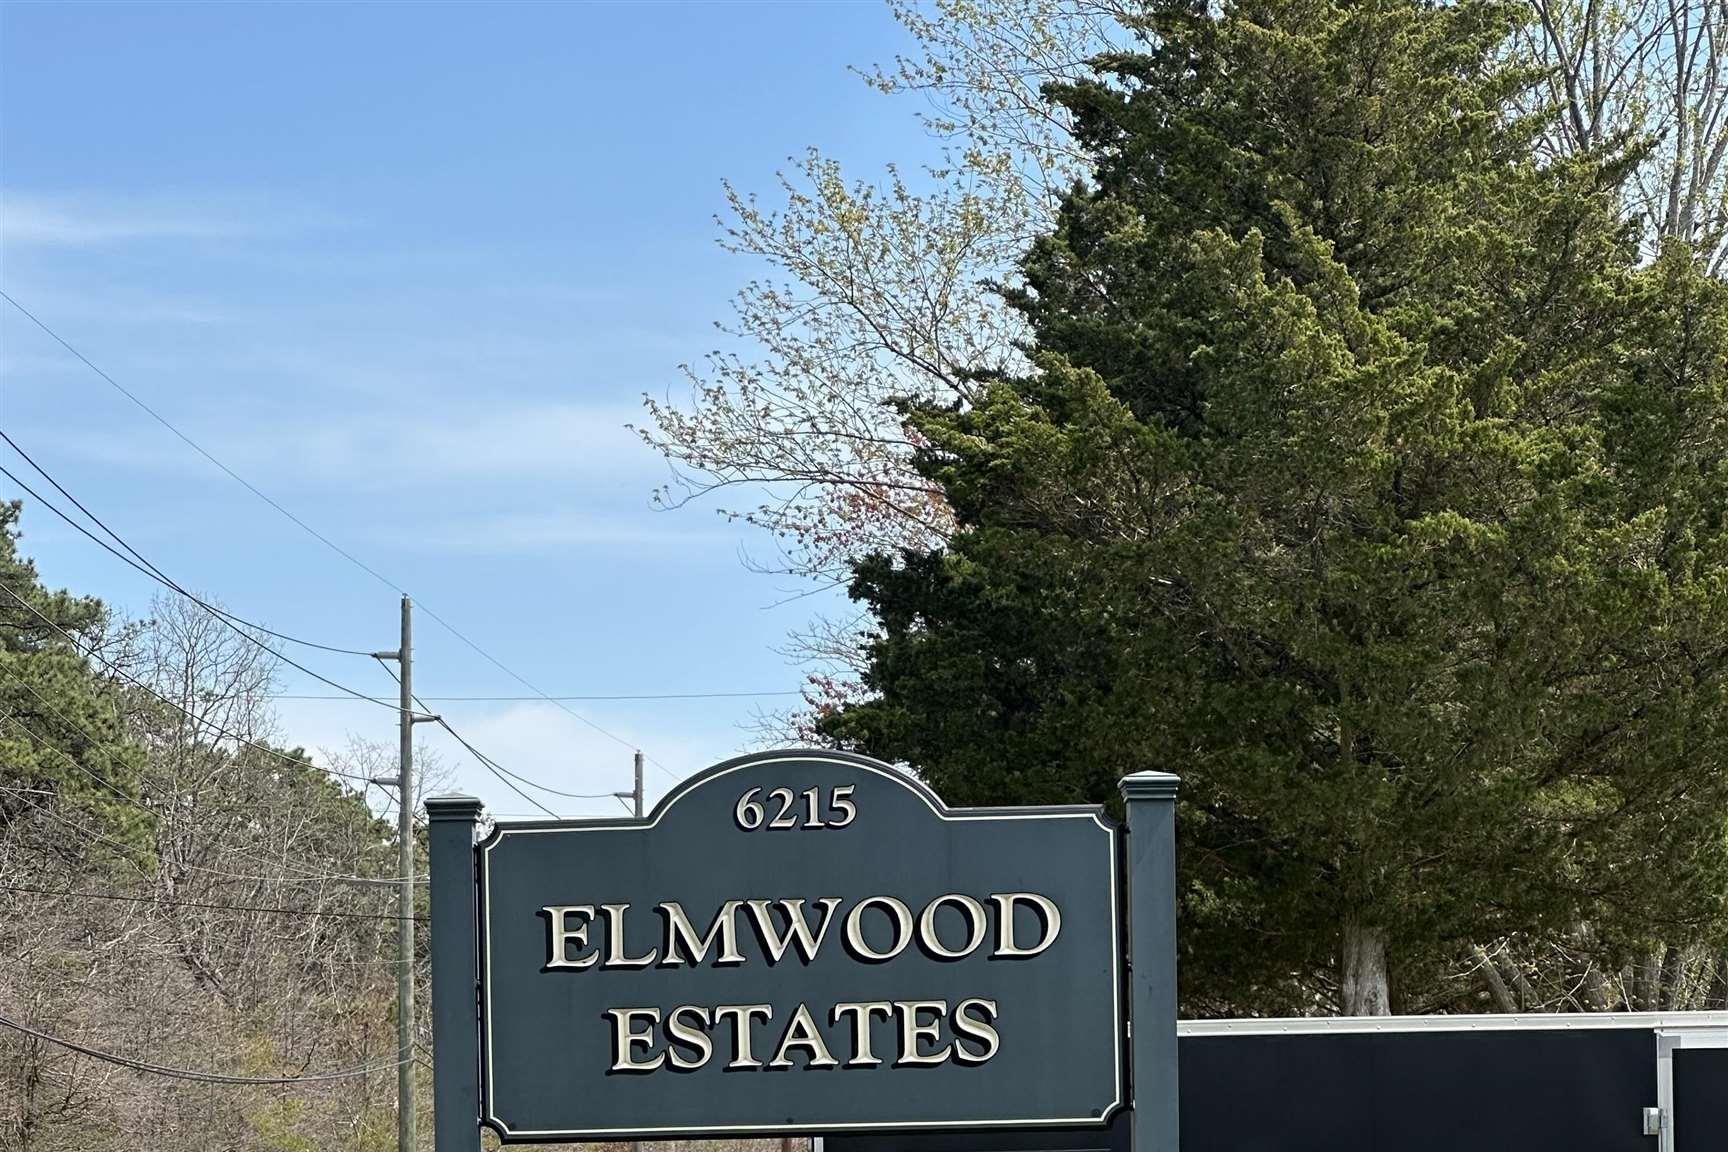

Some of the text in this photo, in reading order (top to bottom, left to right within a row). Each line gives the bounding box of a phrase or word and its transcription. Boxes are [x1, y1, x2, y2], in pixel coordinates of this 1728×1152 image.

[735, 784, 857, 829] 6215
[542, 893, 1062, 969] ELMWOOD
[607, 998, 1000, 1072] ESTATES
